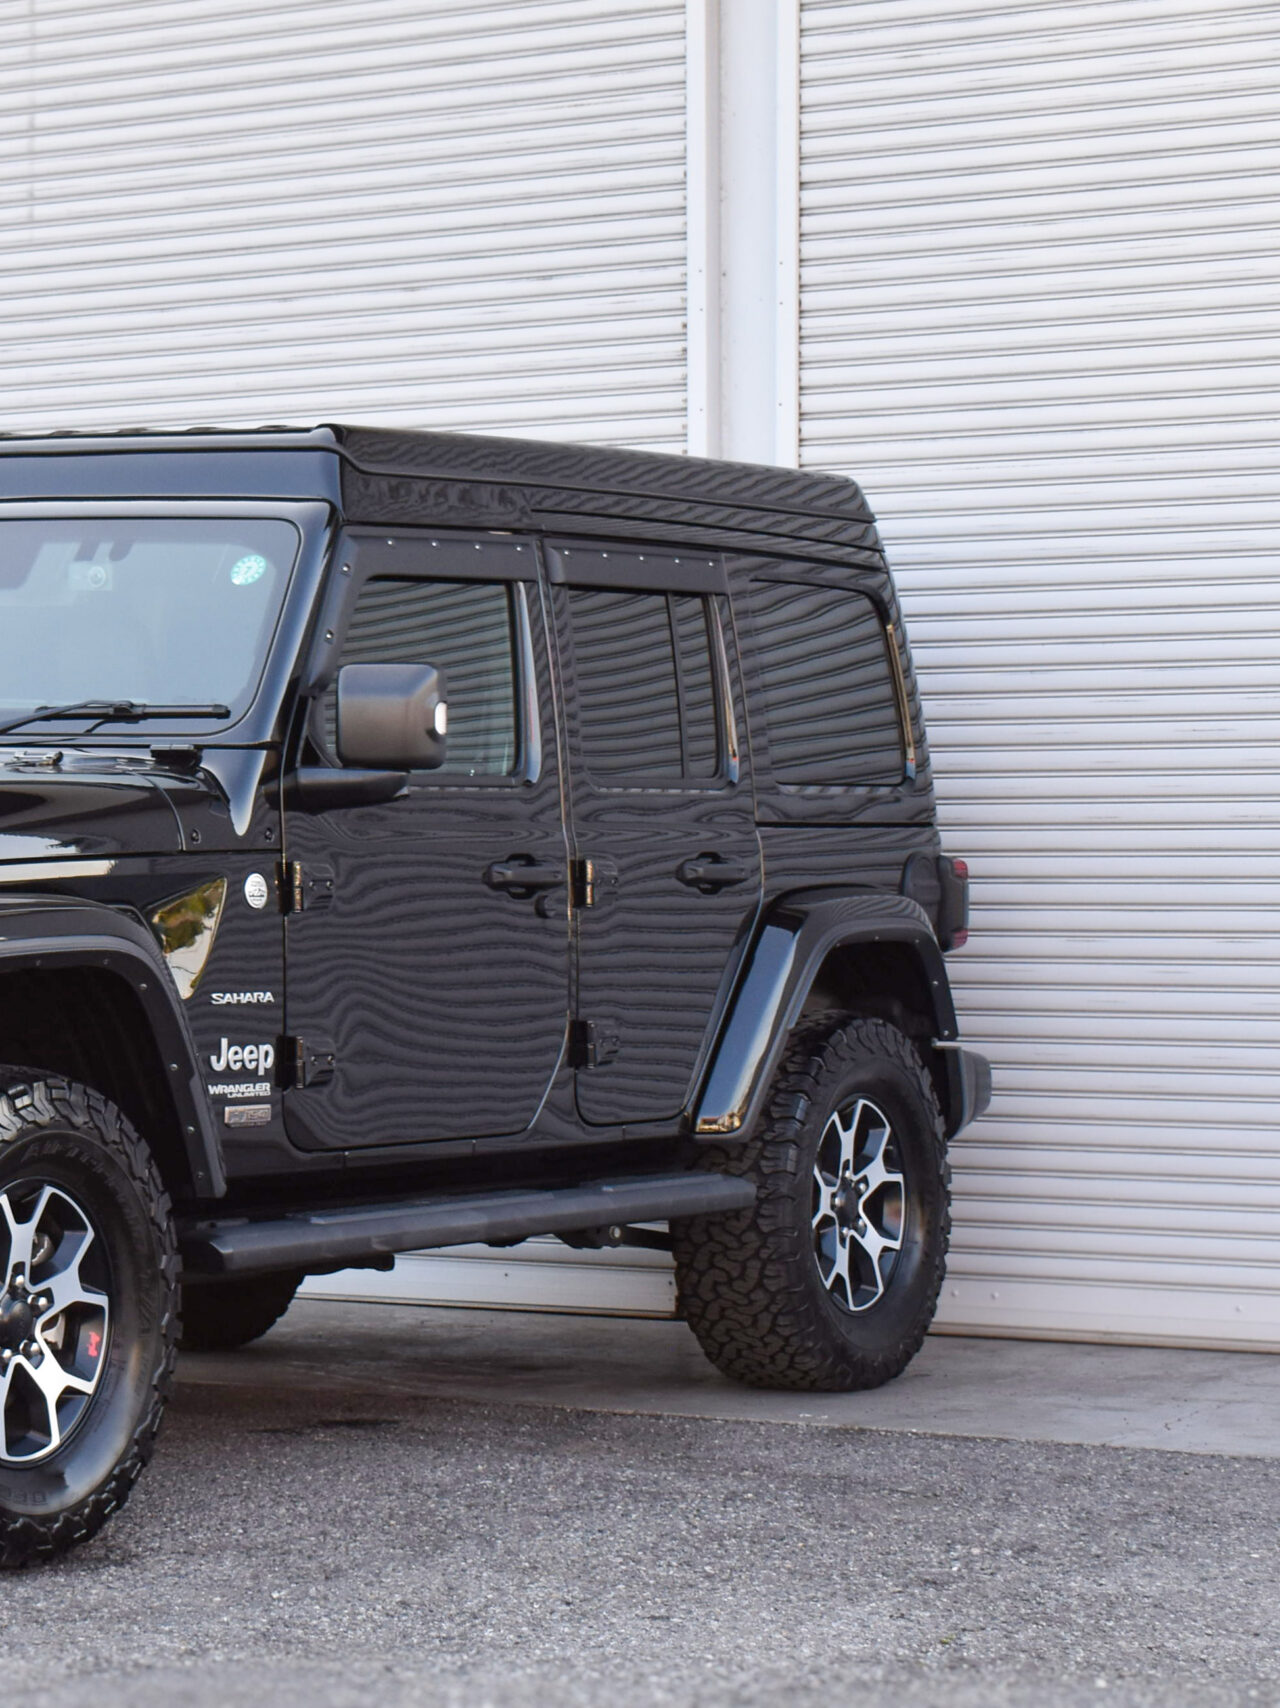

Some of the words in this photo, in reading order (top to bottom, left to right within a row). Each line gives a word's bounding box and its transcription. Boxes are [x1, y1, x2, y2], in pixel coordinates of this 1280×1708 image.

[211, 991, 275, 1005] SAHARA
[210, 1037, 275, 1076] Jeep
[208, 1082, 271, 1095] WRANGLER
[227, 1090, 271, 1099] UNLIMITED
